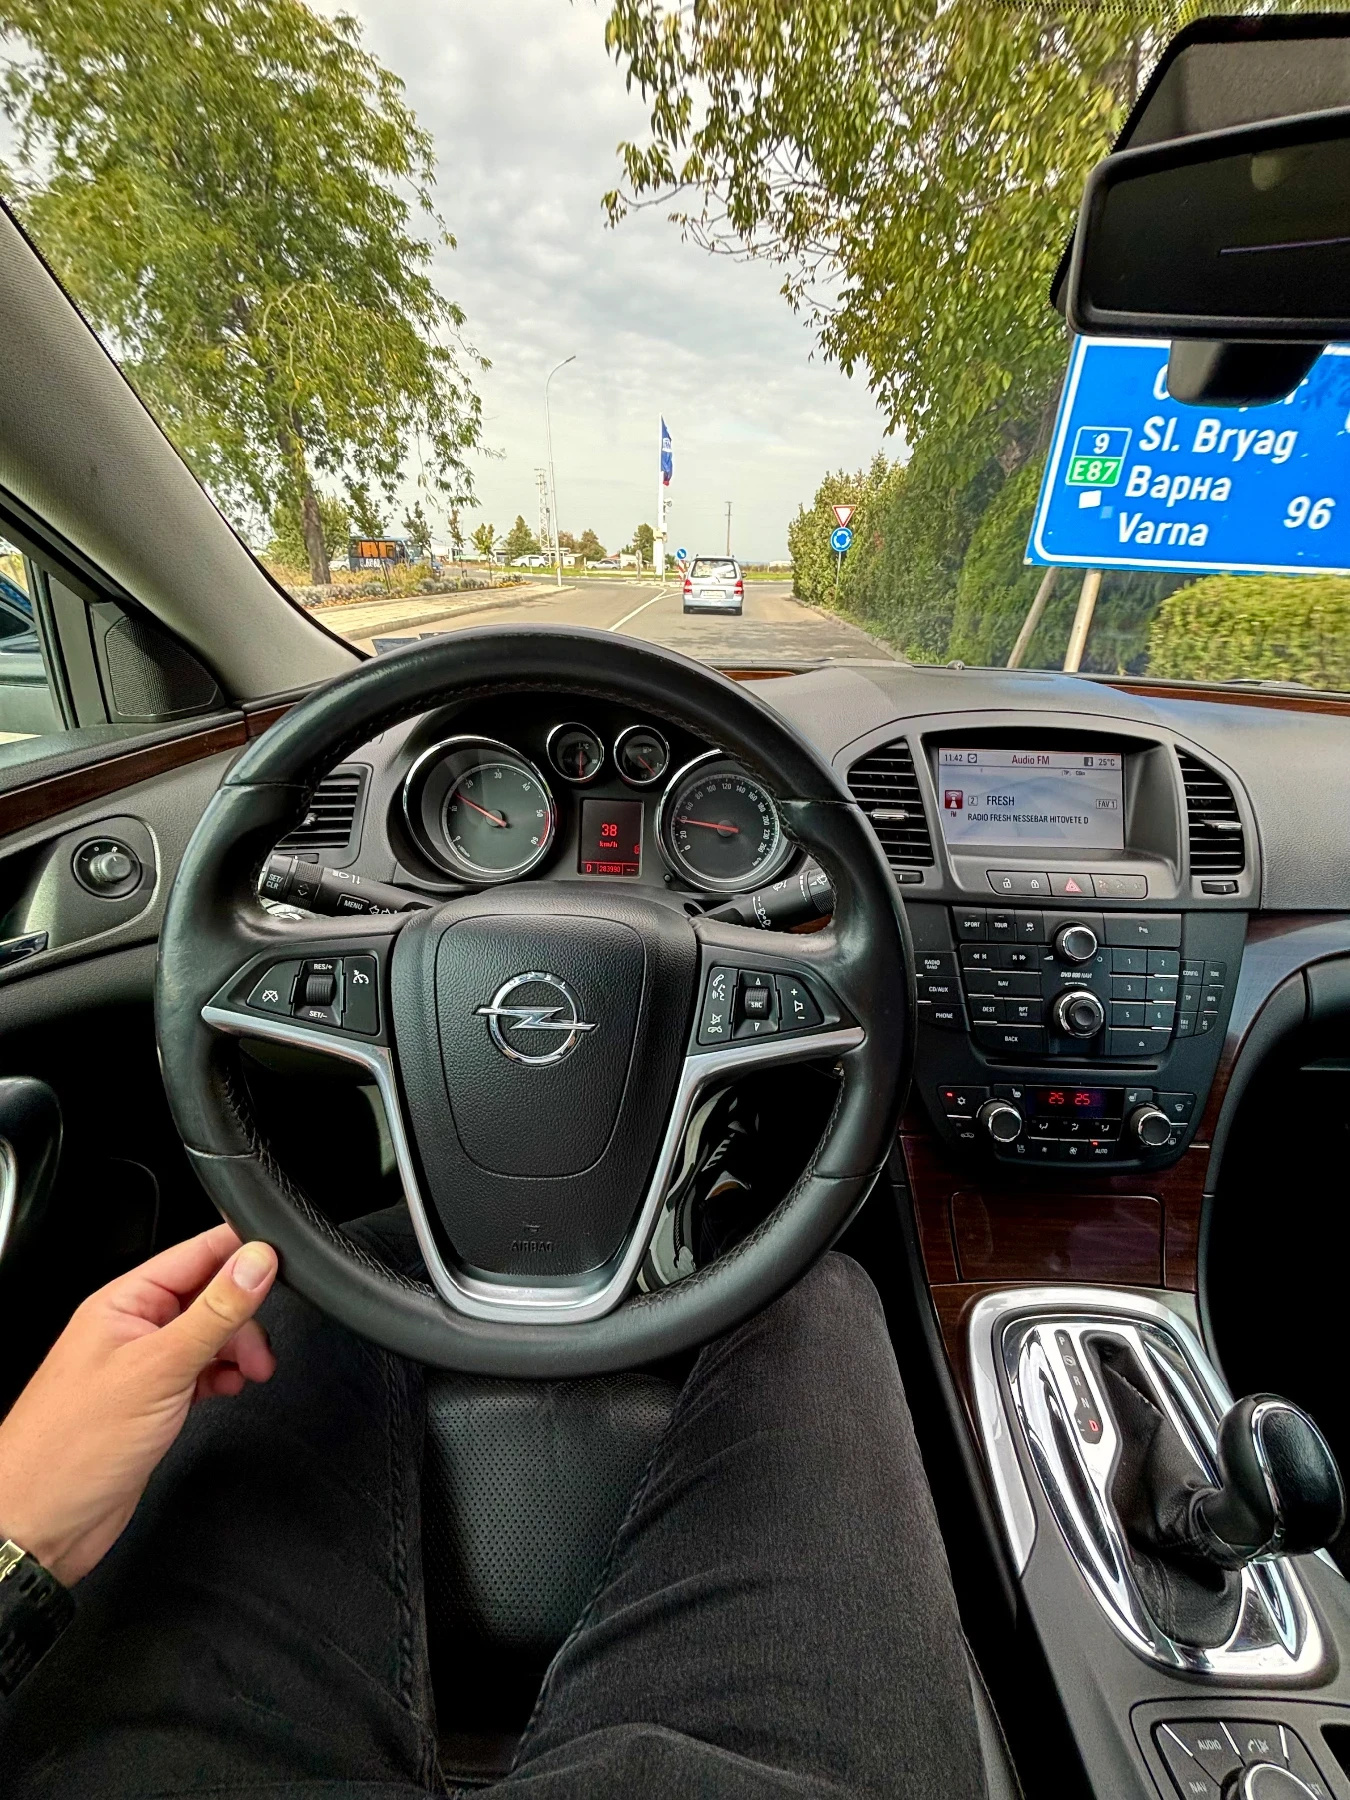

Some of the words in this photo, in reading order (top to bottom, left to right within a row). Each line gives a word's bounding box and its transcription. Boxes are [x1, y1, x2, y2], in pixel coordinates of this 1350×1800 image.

[1093, 433, 1110, 454] 9
[1139, 415, 1180, 451] Sl.
[1192, 418, 1298, 464] Bryag
[1072, 460, 1117, 482] E87
[1125, 465, 1232, 508] Варна
[1284, 496, 1336, 530] 96
[1118, 511, 1209, 547] Varna
[1012, 755, 1035, 764] Audio
[1037, 756, 1050, 765] FM
[1098, 758, 1115, 766] 25°C
[466, 780, 474, 788] 20
[522, 784, 530, 792] 40
[706, 784, 716, 793] 100
[736, 784, 746, 794] 140
[695, 791, 704, 800] 80
[748, 791, 758, 801] 160
[987, 796, 1015, 806] FRESH
[686, 802, 693, 811] 60
[1013, 815, 1048, 823] NESSEBAR
[1050, 816, 1082, 824] HITOVETE
[602, 824, 617, 836] 38
[680, 830, 687, 838] 20
[531, 836, 538, 845] 60
[586, 864, 592, 872] D
[268, 873, 283, 882] SET/
[266, 880, 279, 889] CLR
[344, 900, 363, 910] MENU
[1049, 1092, 1064, 1104] 25
[1075, 1093, 1090, 1105] 25
[1089, 1420, 1098, 1432] D
[1198, 1740, 1222, 1750] AUDIO
[1189, 1782, 1207, 1793] NAV
